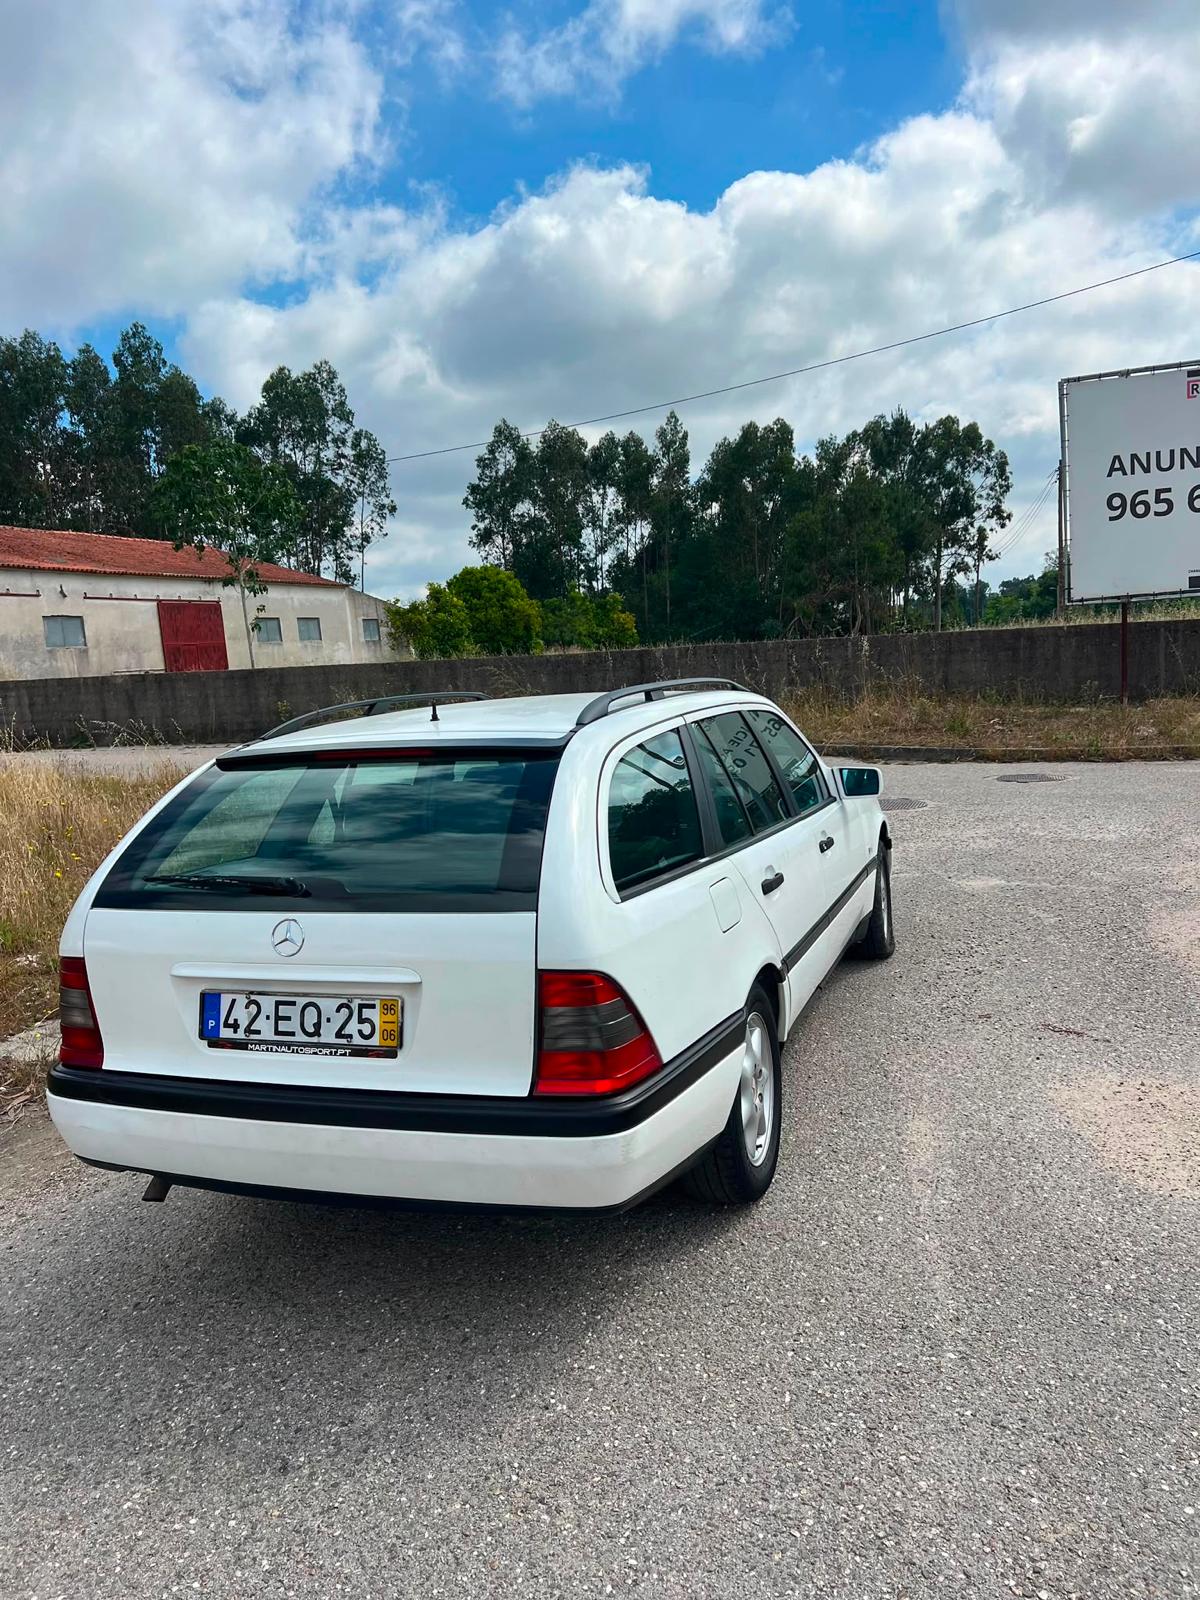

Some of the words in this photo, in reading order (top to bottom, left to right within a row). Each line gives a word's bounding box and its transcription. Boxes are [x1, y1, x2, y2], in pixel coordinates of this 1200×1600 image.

[1106, 487, 1174, 522] 965
[382, 1003, 397, 1016] 96
[208, 1020, 216, 1030] P
[382, 1028, 396, 1042] 06
[247, 1043, 352, 1057] MARTINAUTOSPORT.PT
